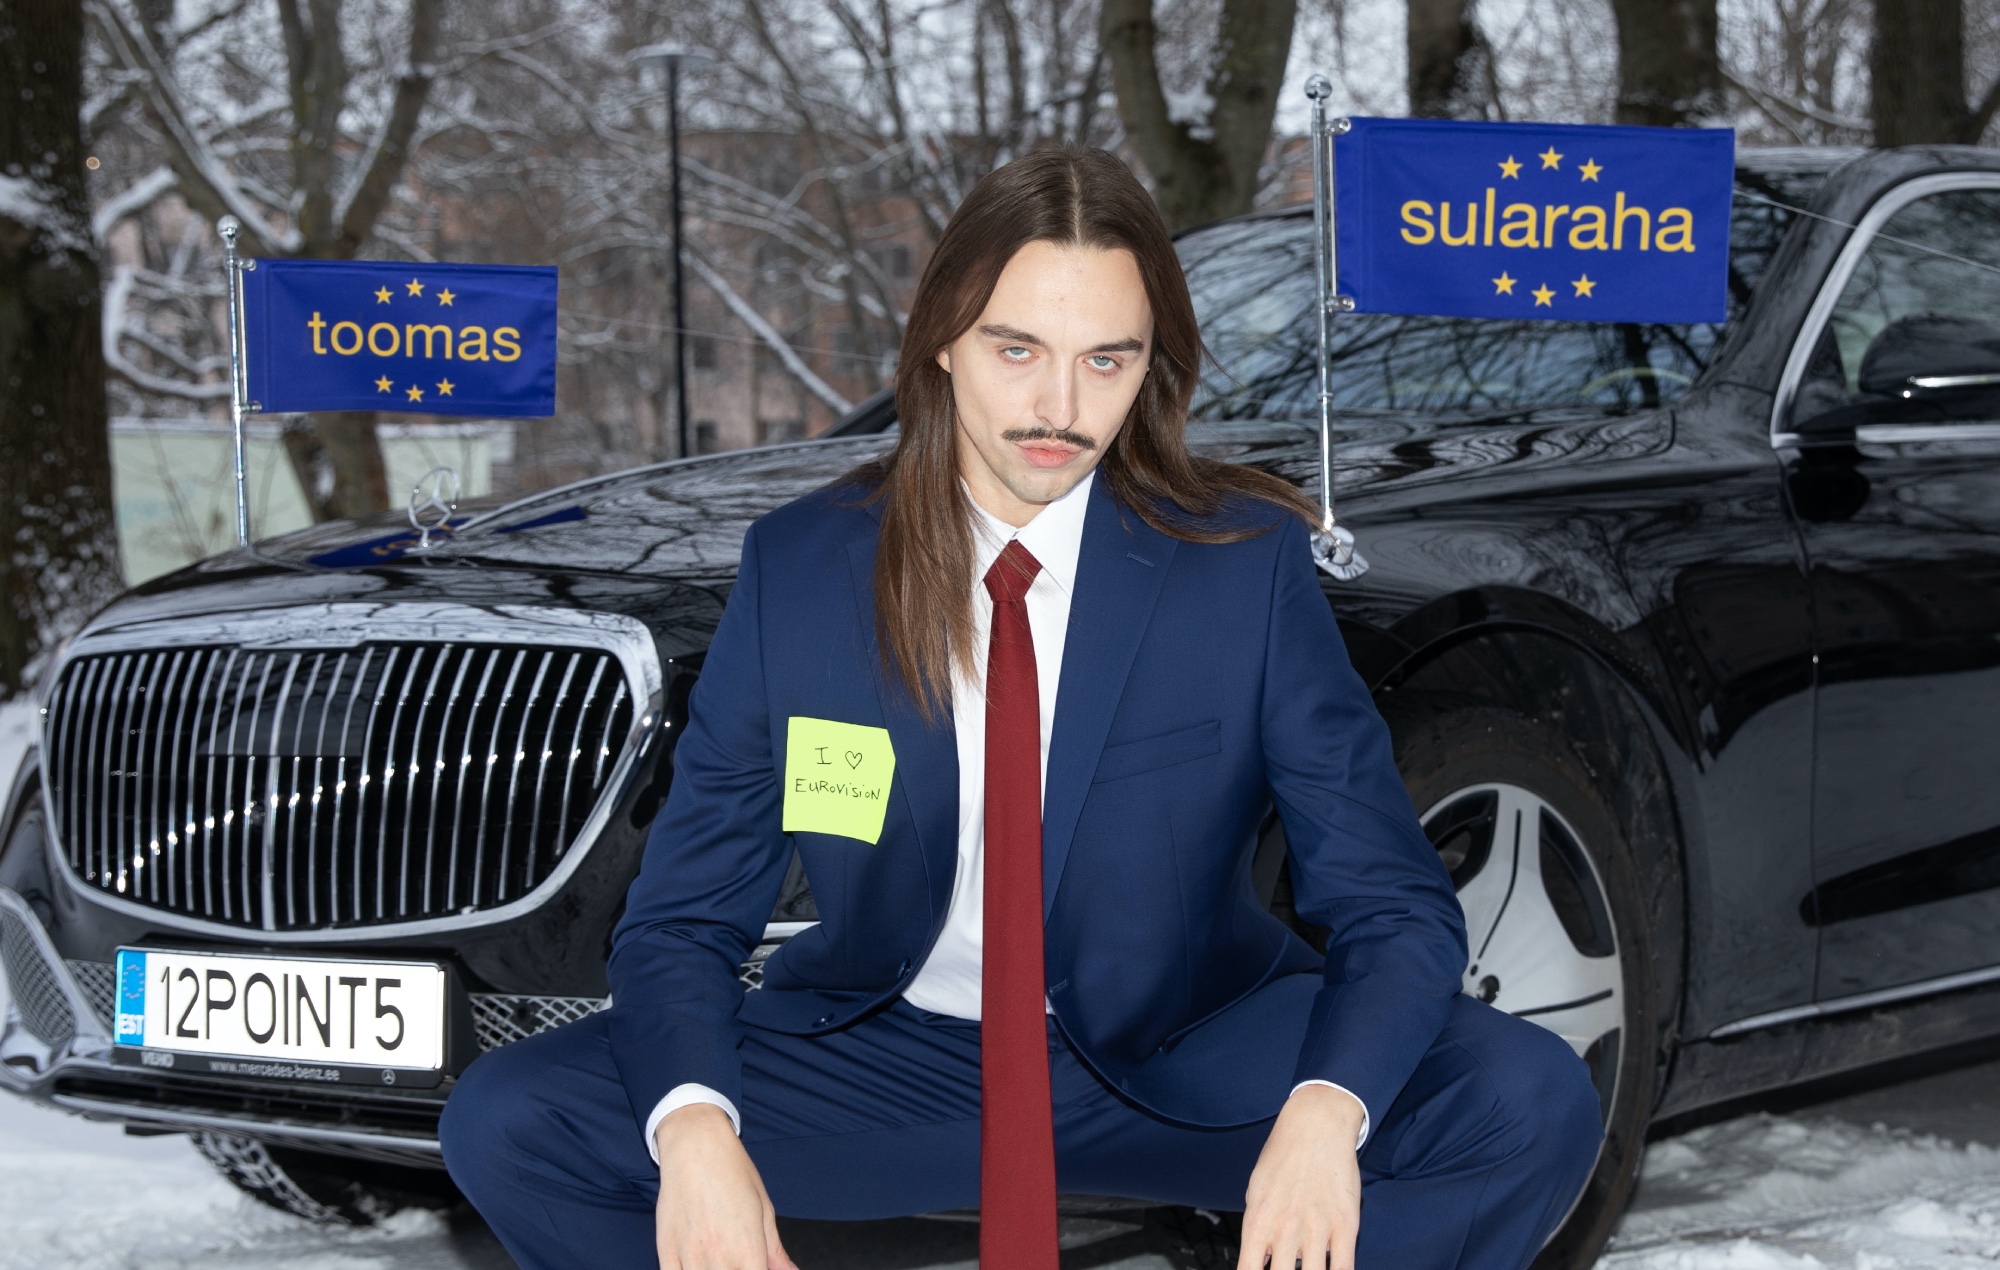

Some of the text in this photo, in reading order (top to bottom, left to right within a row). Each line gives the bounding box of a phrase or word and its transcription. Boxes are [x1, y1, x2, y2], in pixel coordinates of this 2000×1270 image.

[1400, 187, 1695, 252] sularaha
[308, 311, 521, 362] toomas
[815, 746, 832, 765] I
[120, 1013, 144, 1035] EST
[161, 966, 404, 1051] 12POINT5
[208, 1061, 341, 1081] www.mercedes-benz.ee
